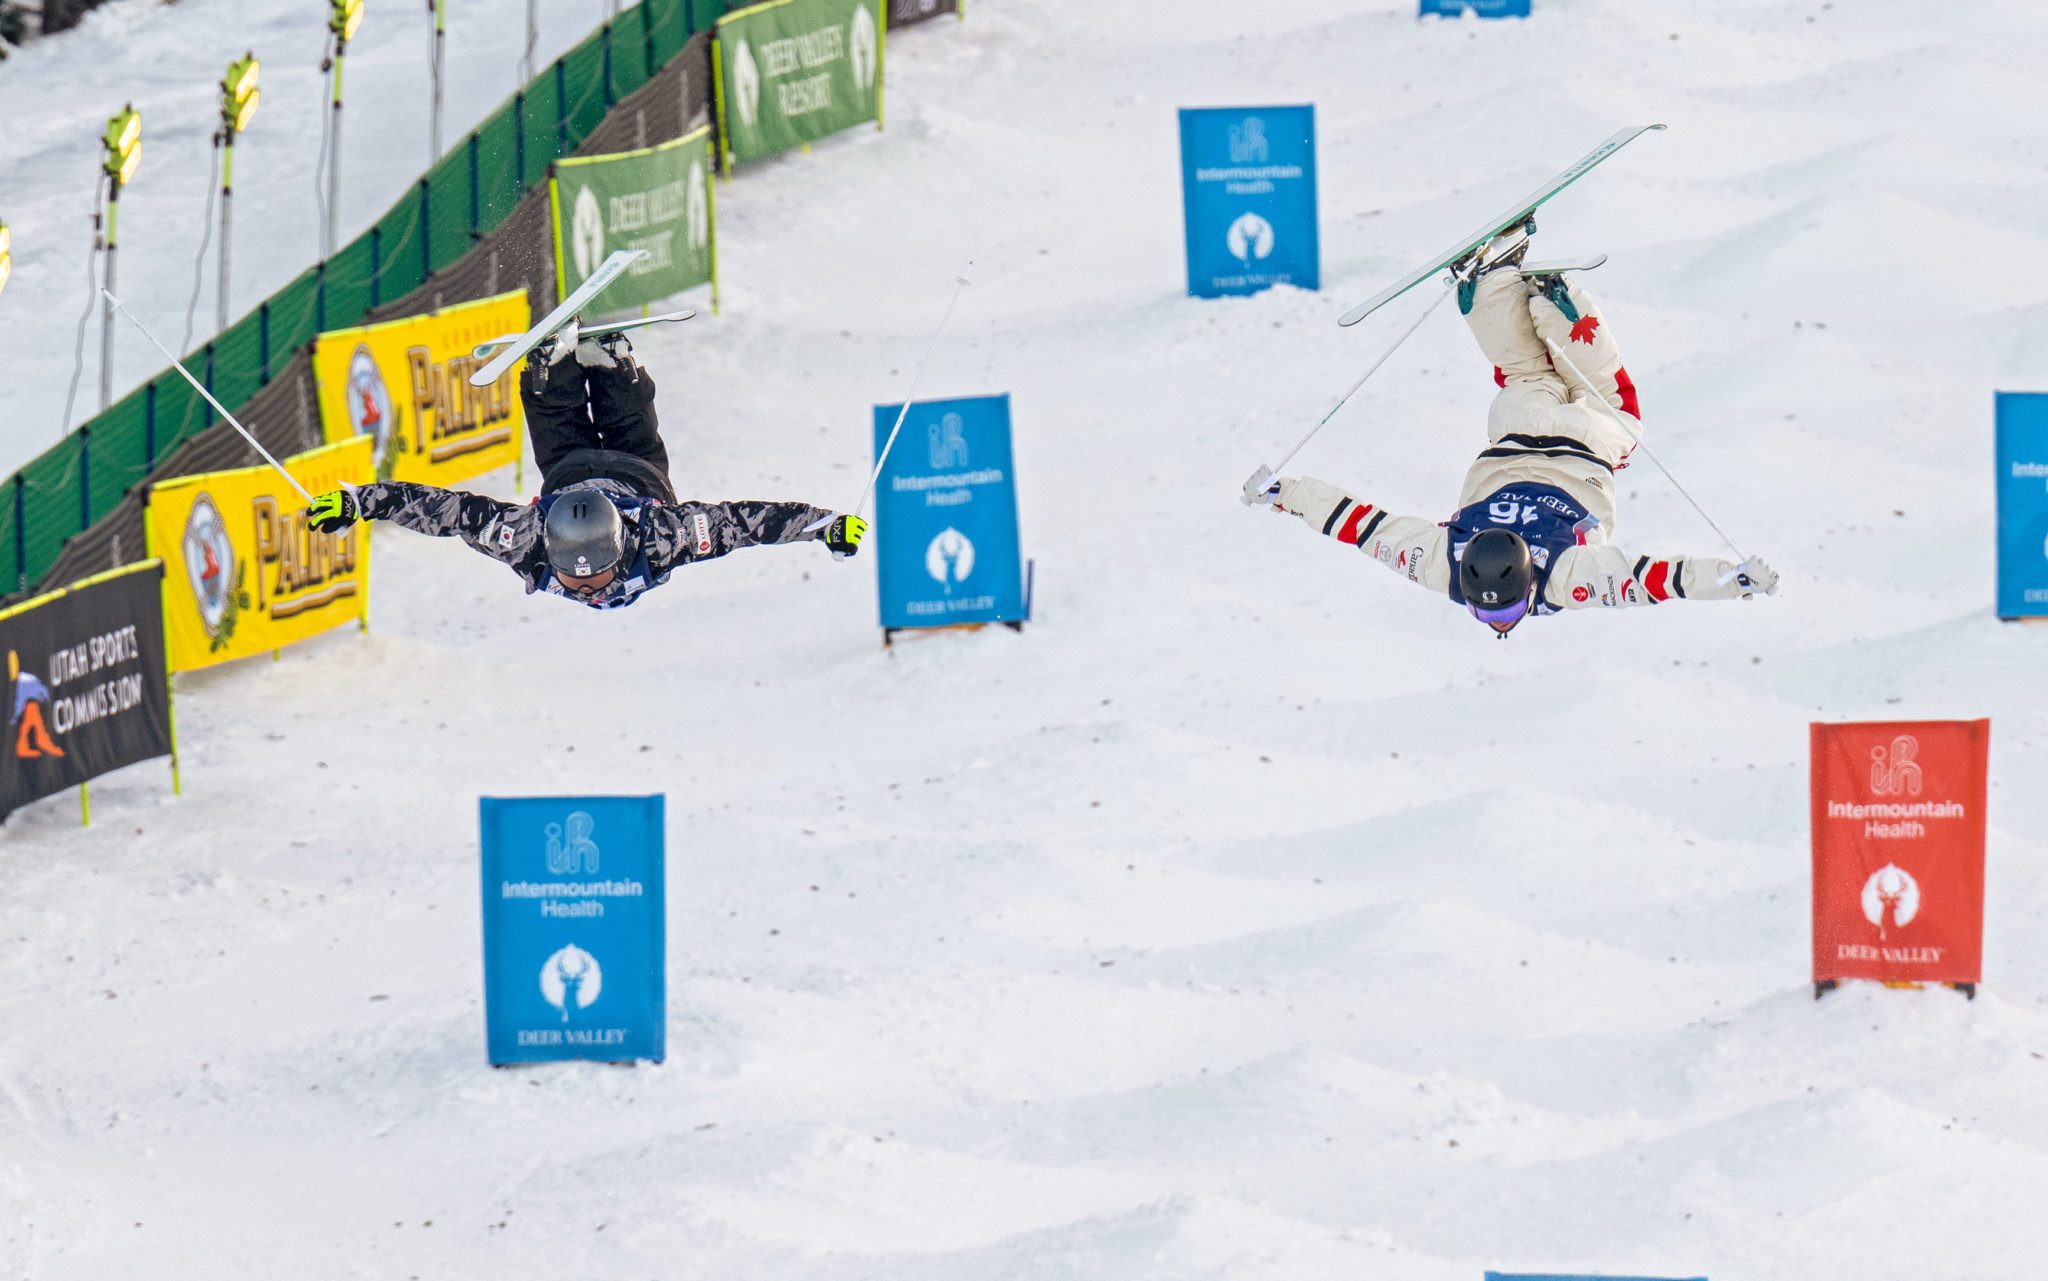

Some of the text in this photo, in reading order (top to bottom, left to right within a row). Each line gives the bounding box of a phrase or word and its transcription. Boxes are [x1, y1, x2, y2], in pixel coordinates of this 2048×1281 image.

[1488, 501, 1538, 524] 16
[833, 519, 842, 543] FXR
[50, 624, 139, 687] UTAH SPORTS
[52, 673, 143, 734] COMMISSION
[1828, 800, 1964, 818] Intermountain
[1864, 821, 1925, 838] Health
[502, 878, 643, 898] Intermountain
[541, 900, 604, 917] Health
[1882, 946, 1941, 962] VALLEY
[517, 1028, 626, 1045] DEER VALLEY
